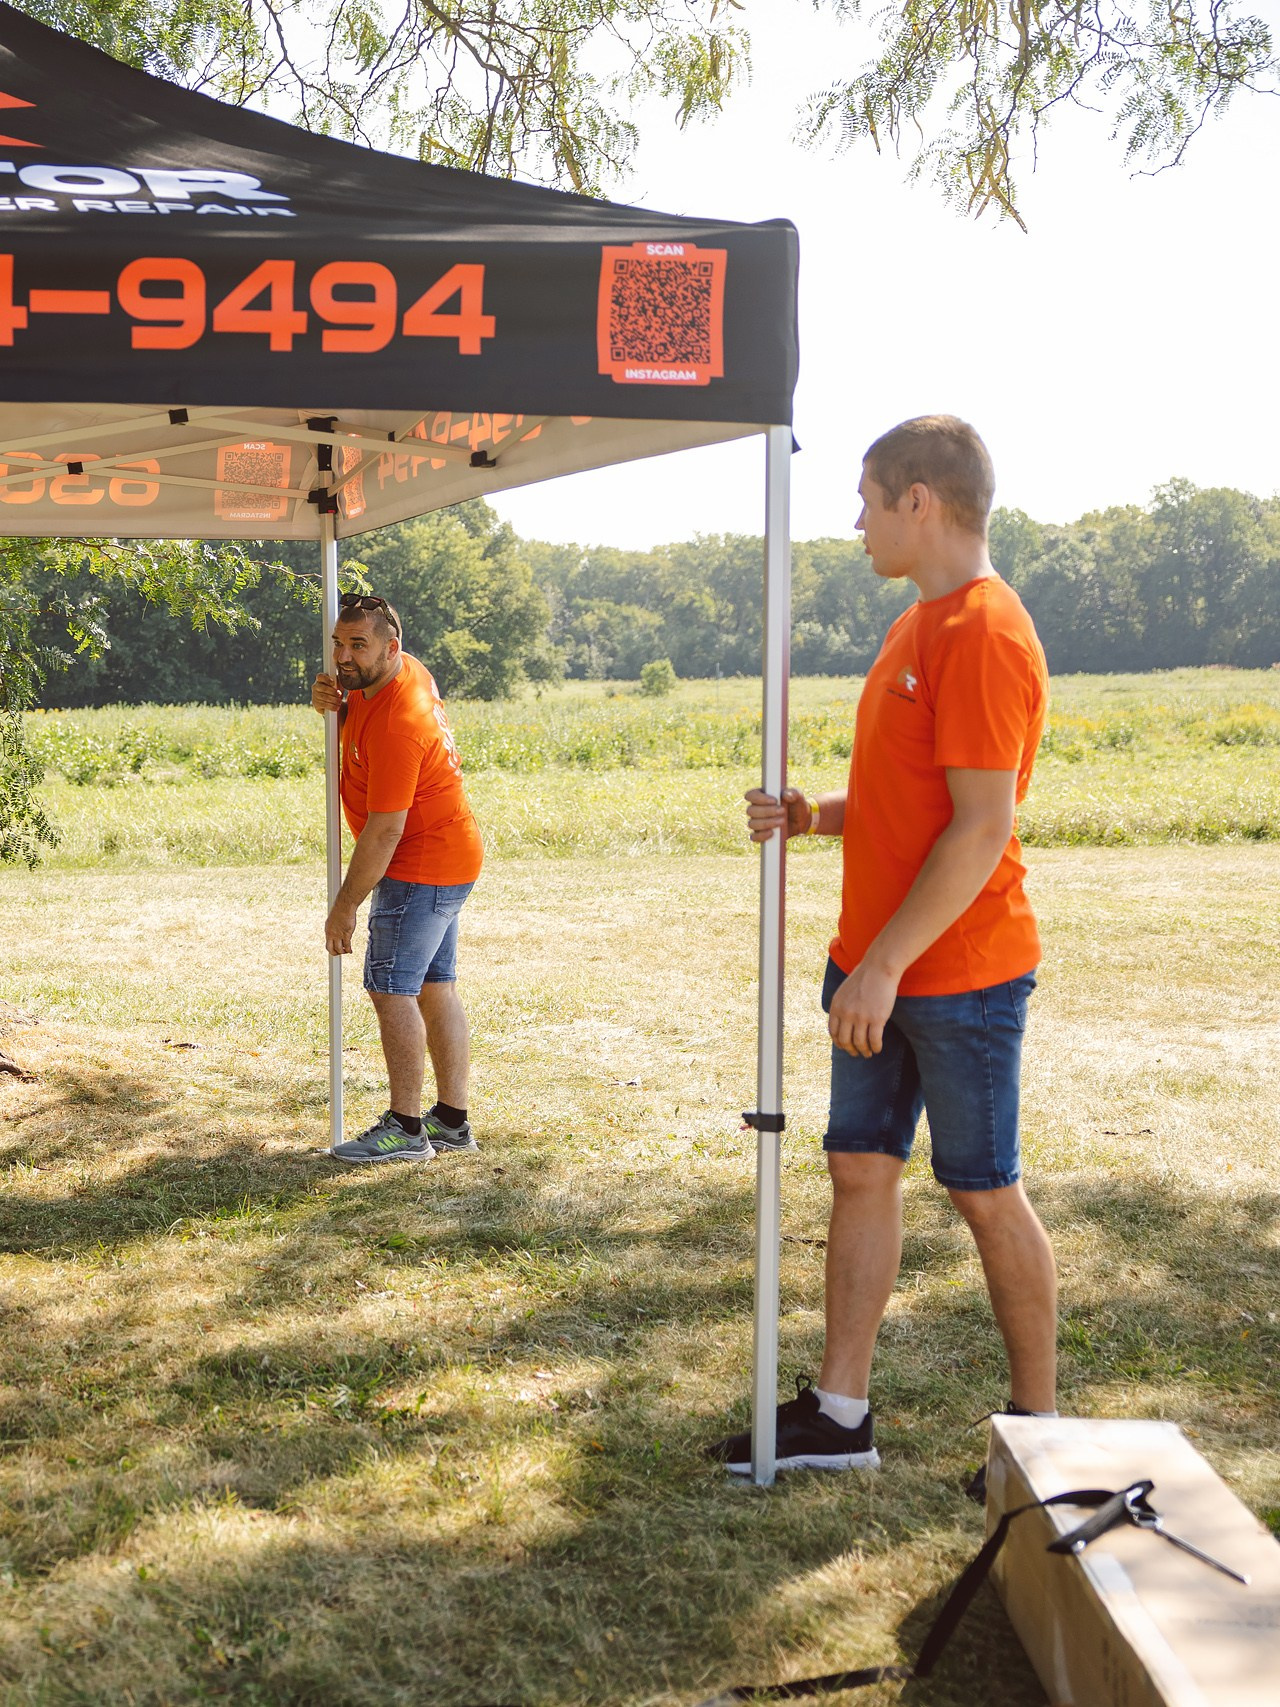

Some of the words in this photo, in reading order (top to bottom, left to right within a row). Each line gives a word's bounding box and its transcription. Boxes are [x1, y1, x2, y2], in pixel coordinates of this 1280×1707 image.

[71, 198, 298, 217] REPAIR
[646, 244, 685, 256] SCAN
[624, 368, 697, 381] INSTAGRAM
